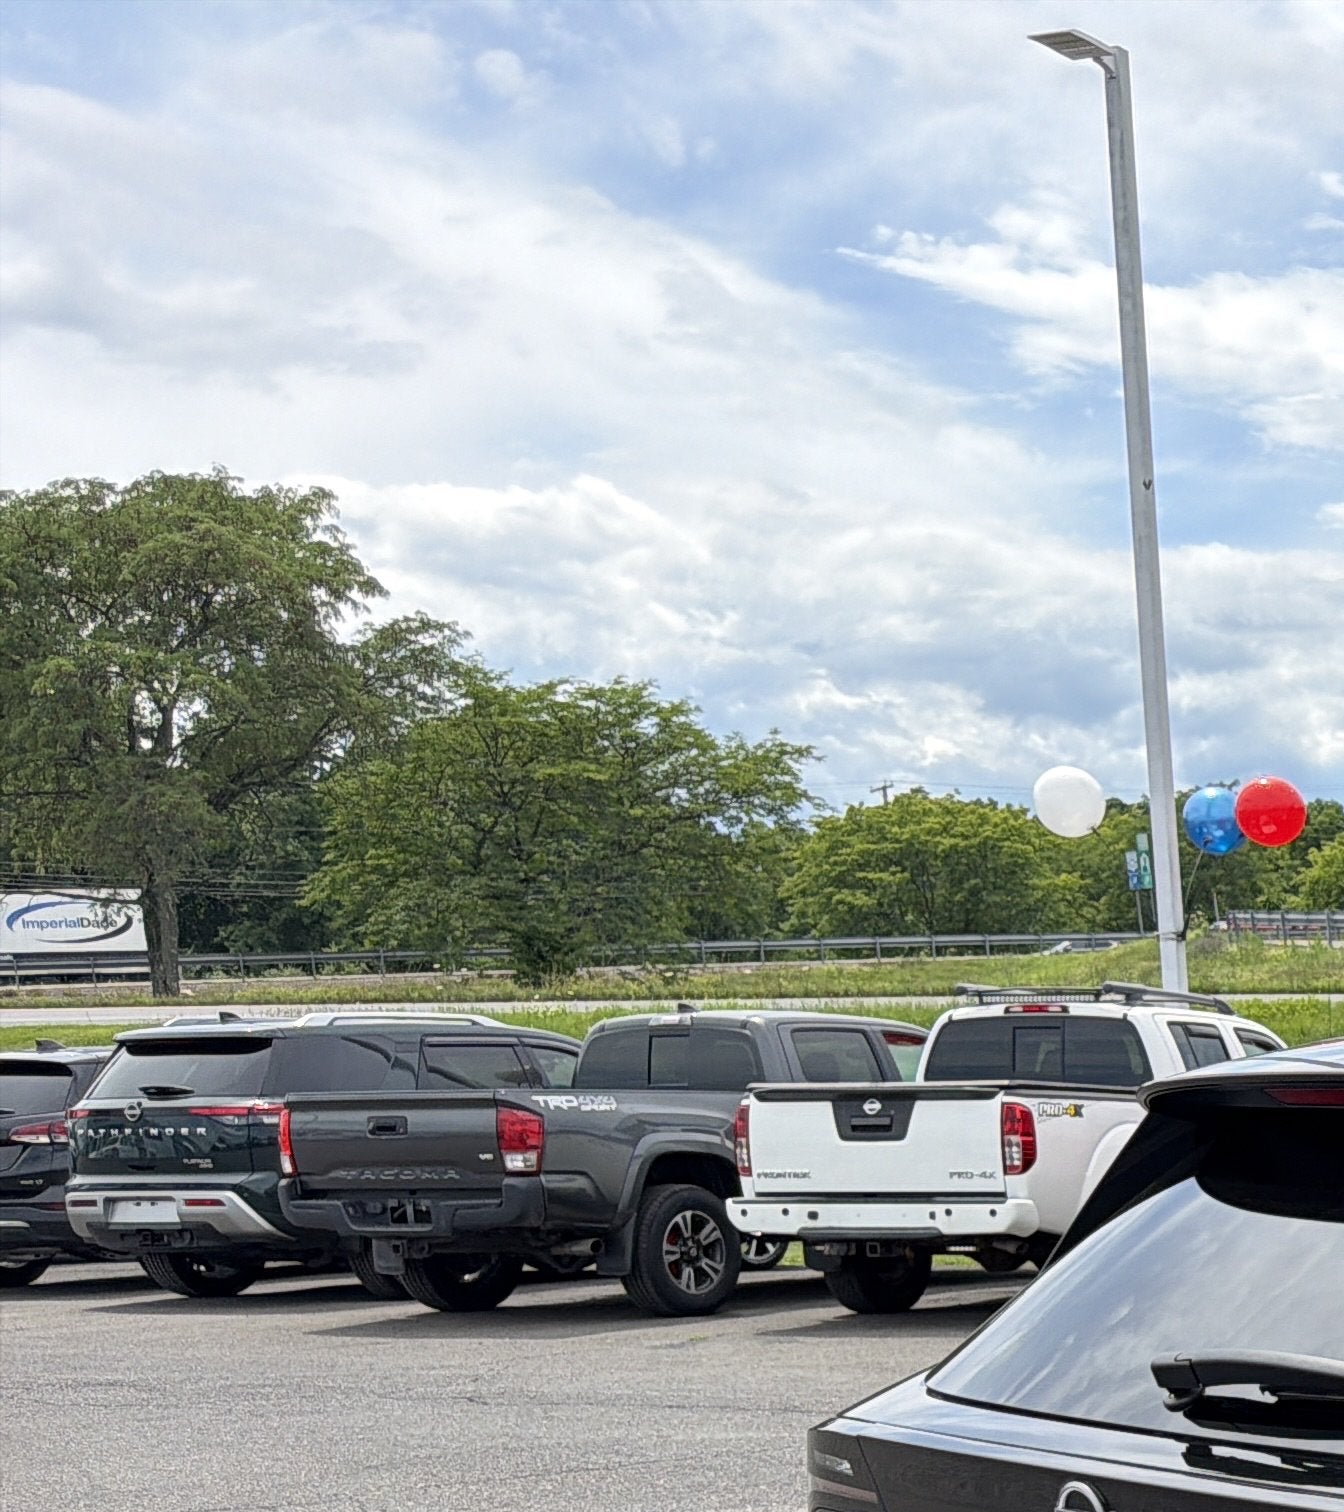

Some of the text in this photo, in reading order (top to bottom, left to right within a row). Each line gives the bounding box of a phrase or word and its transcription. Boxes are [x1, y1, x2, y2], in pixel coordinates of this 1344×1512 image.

[77, 1127, 207, 1137] PATHFINDER
[340, 1168, 460, 1180] TACOMA
[949, 1171, 996, 1179] PRO-4X
